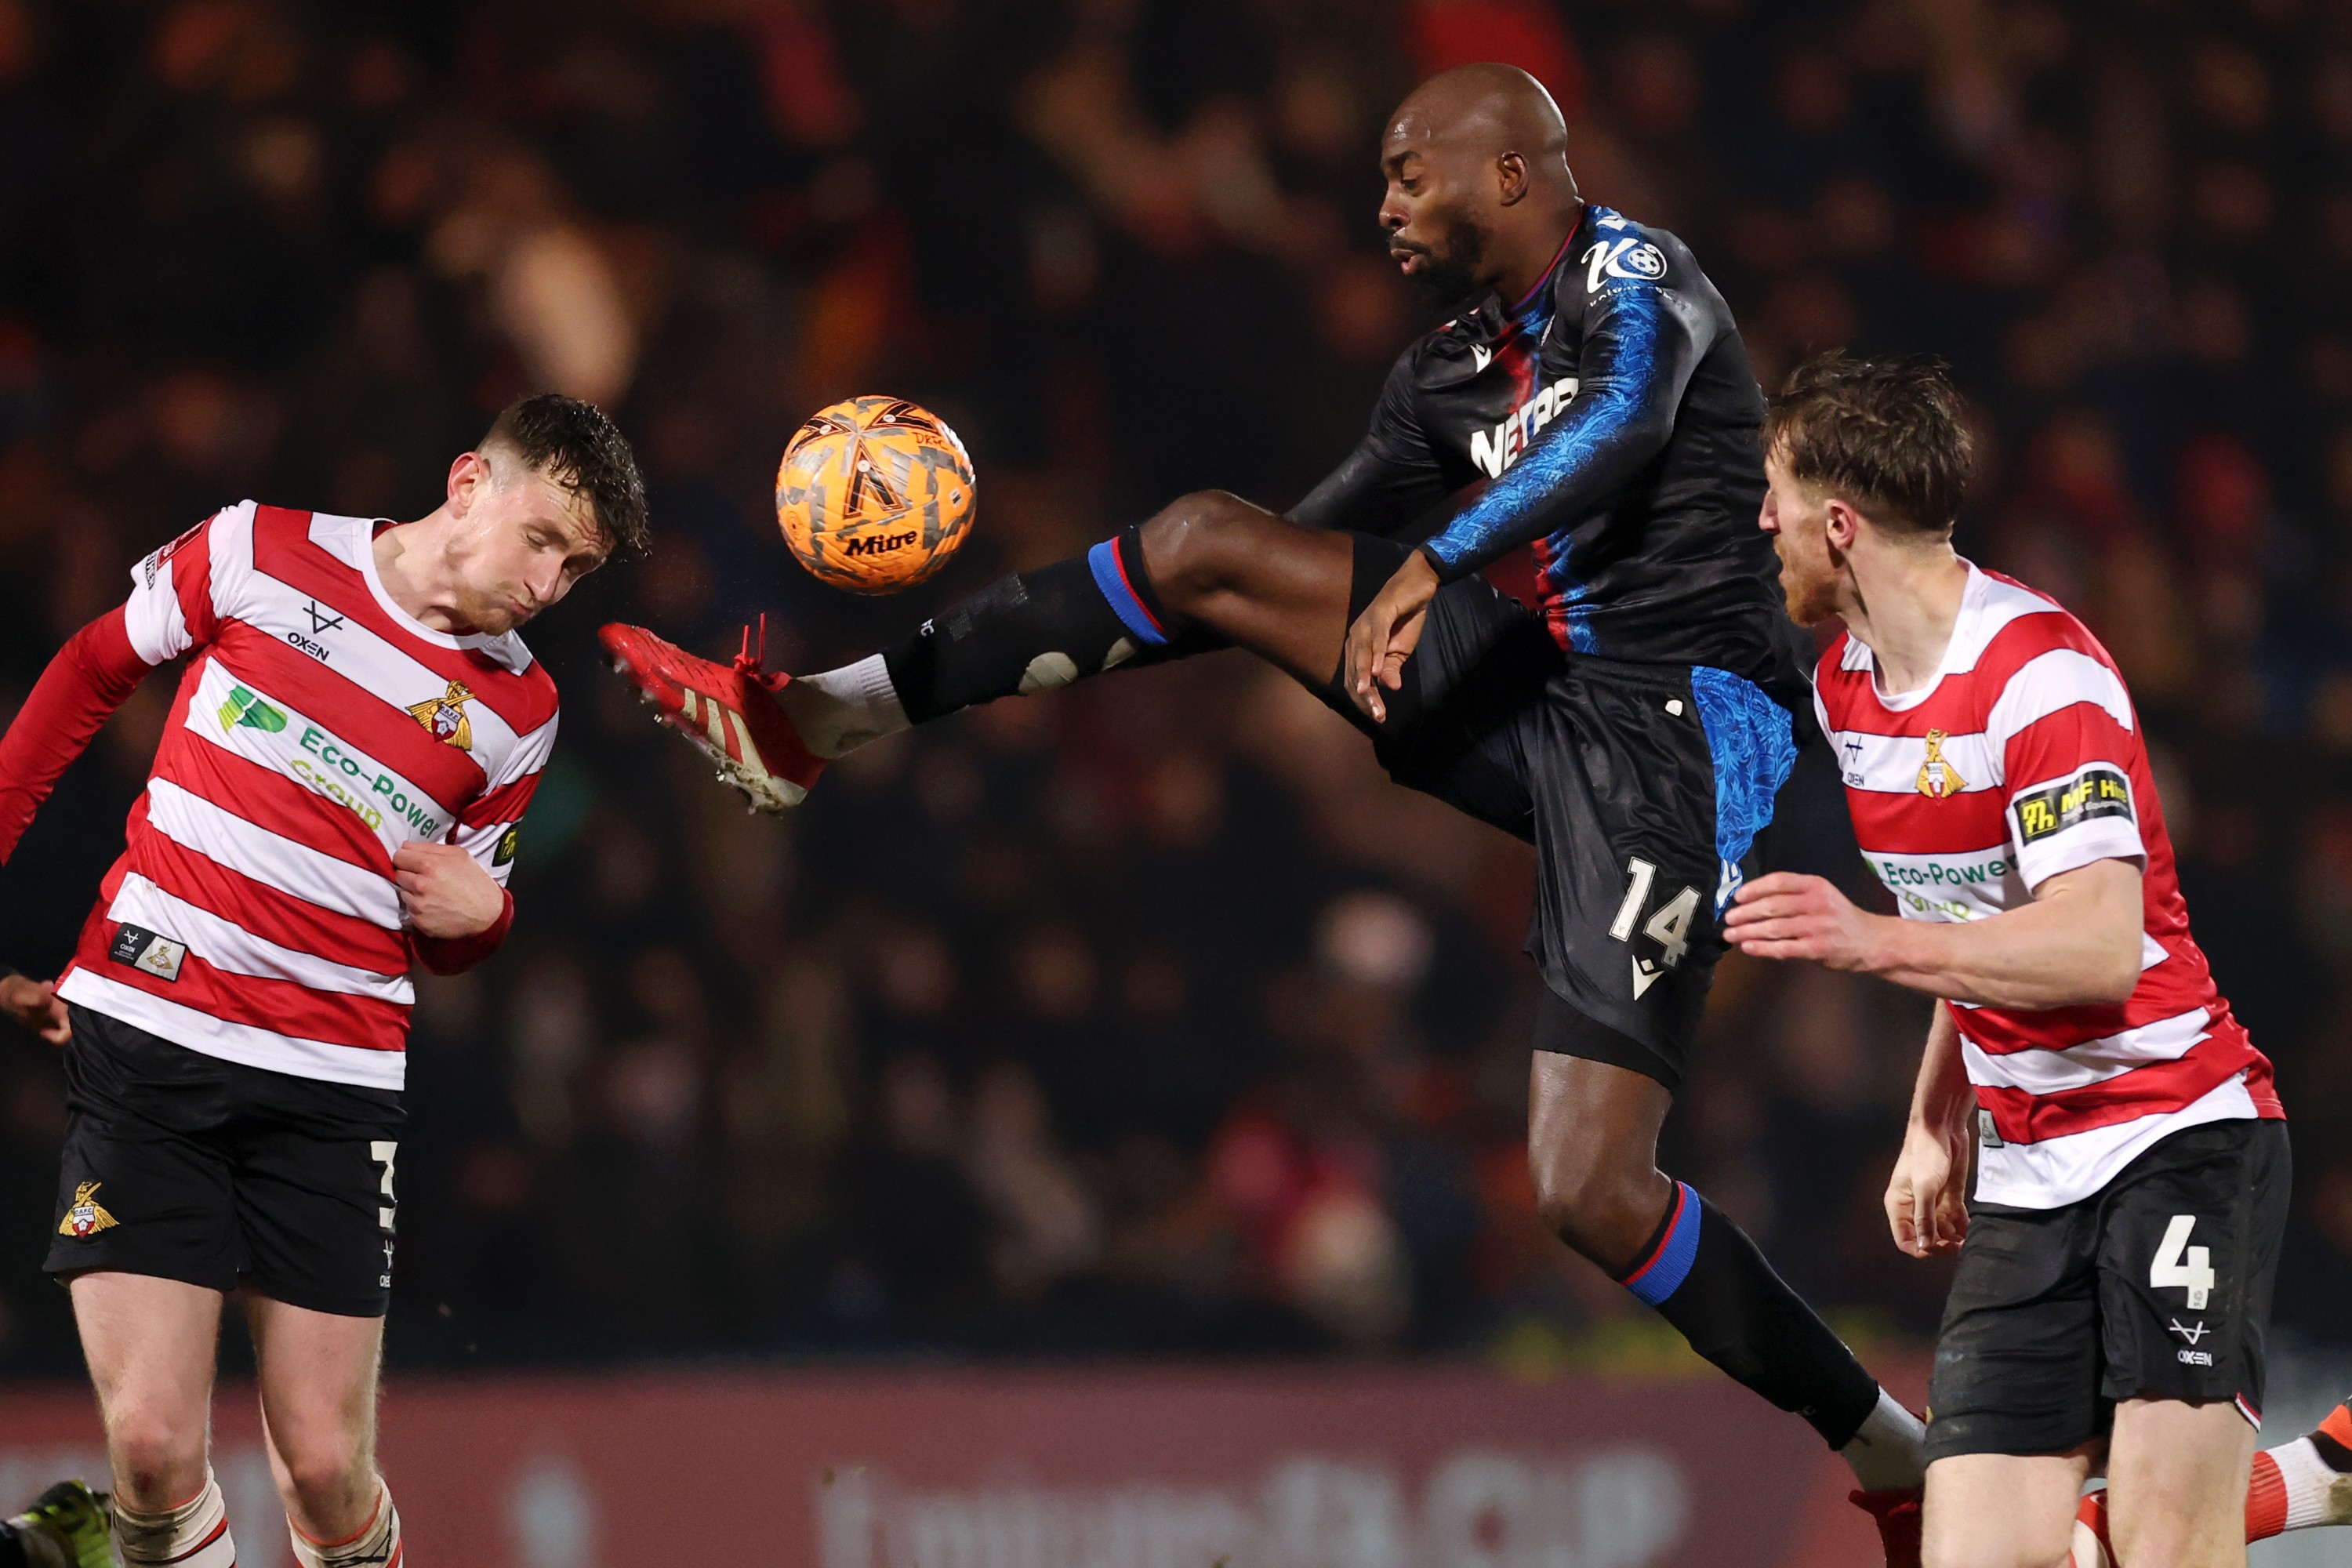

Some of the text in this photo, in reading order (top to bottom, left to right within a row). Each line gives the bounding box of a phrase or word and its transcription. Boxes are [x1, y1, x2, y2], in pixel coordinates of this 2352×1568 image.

[844, 531, 916, 556] Mitre
[288, 632, 330, 661] OXEN
[299, 727, 441, 838] Eco-Power
[2060, 781, 2093, 813] MF
[1609, 856, 1702, 969] 14
[2151, 1214, 2215, 1310] 4
[2177, 1349, 2213, 1367] OXEN
